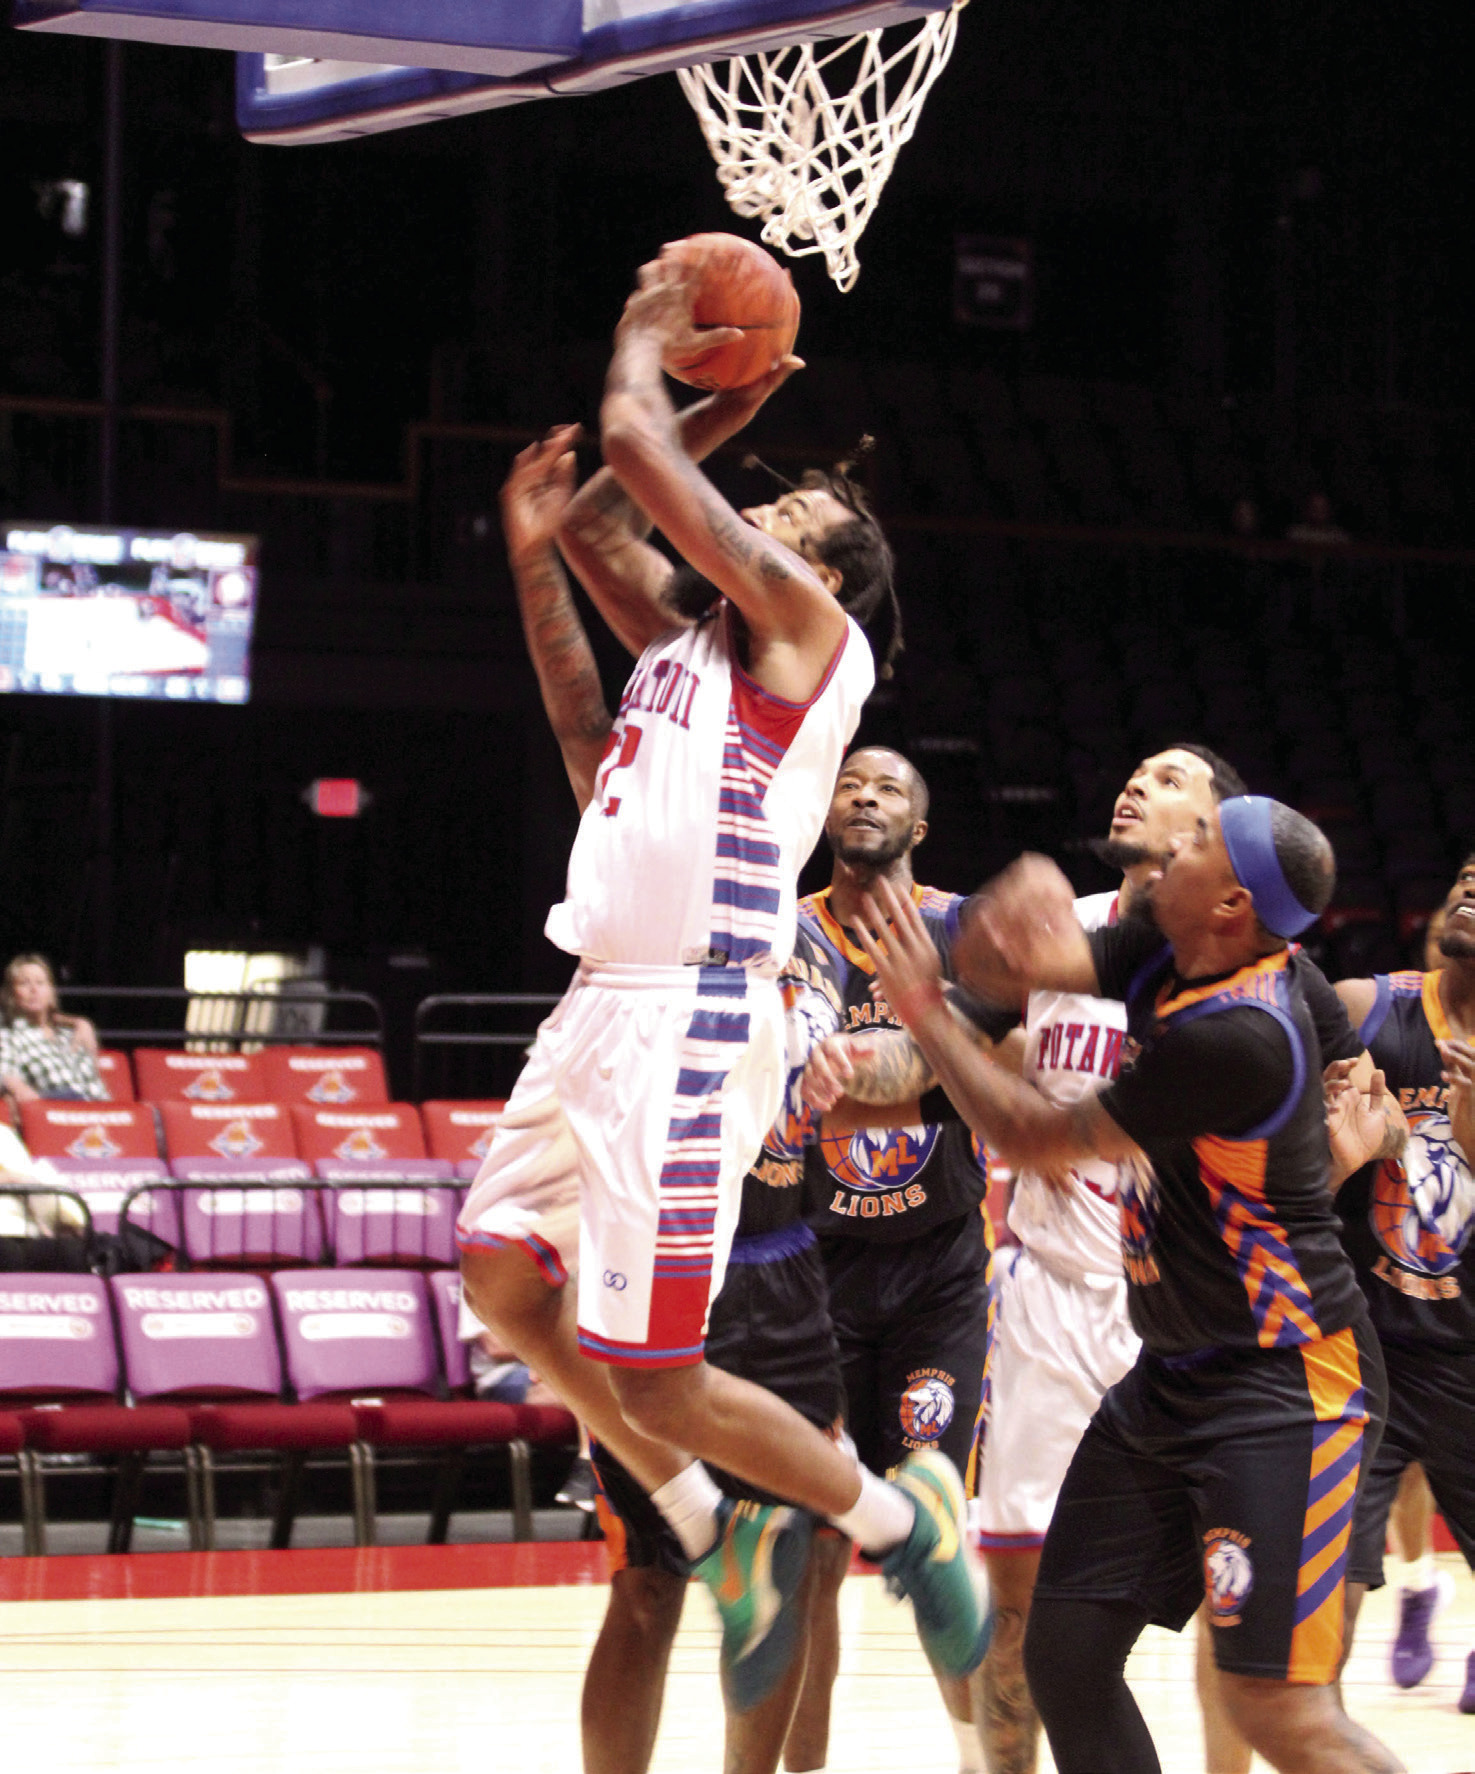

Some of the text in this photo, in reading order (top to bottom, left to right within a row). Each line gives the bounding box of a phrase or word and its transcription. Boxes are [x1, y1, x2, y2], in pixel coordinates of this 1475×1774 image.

[870, 1135, 918, 1178] ML
[829, 1184, 927, 1218] LIONS
[123, 1286, 264, 1311] RESERVED
[285, 1288, 418, 1313] RESERVED
[906, 1368, 956, 1387] MEMPHIS
